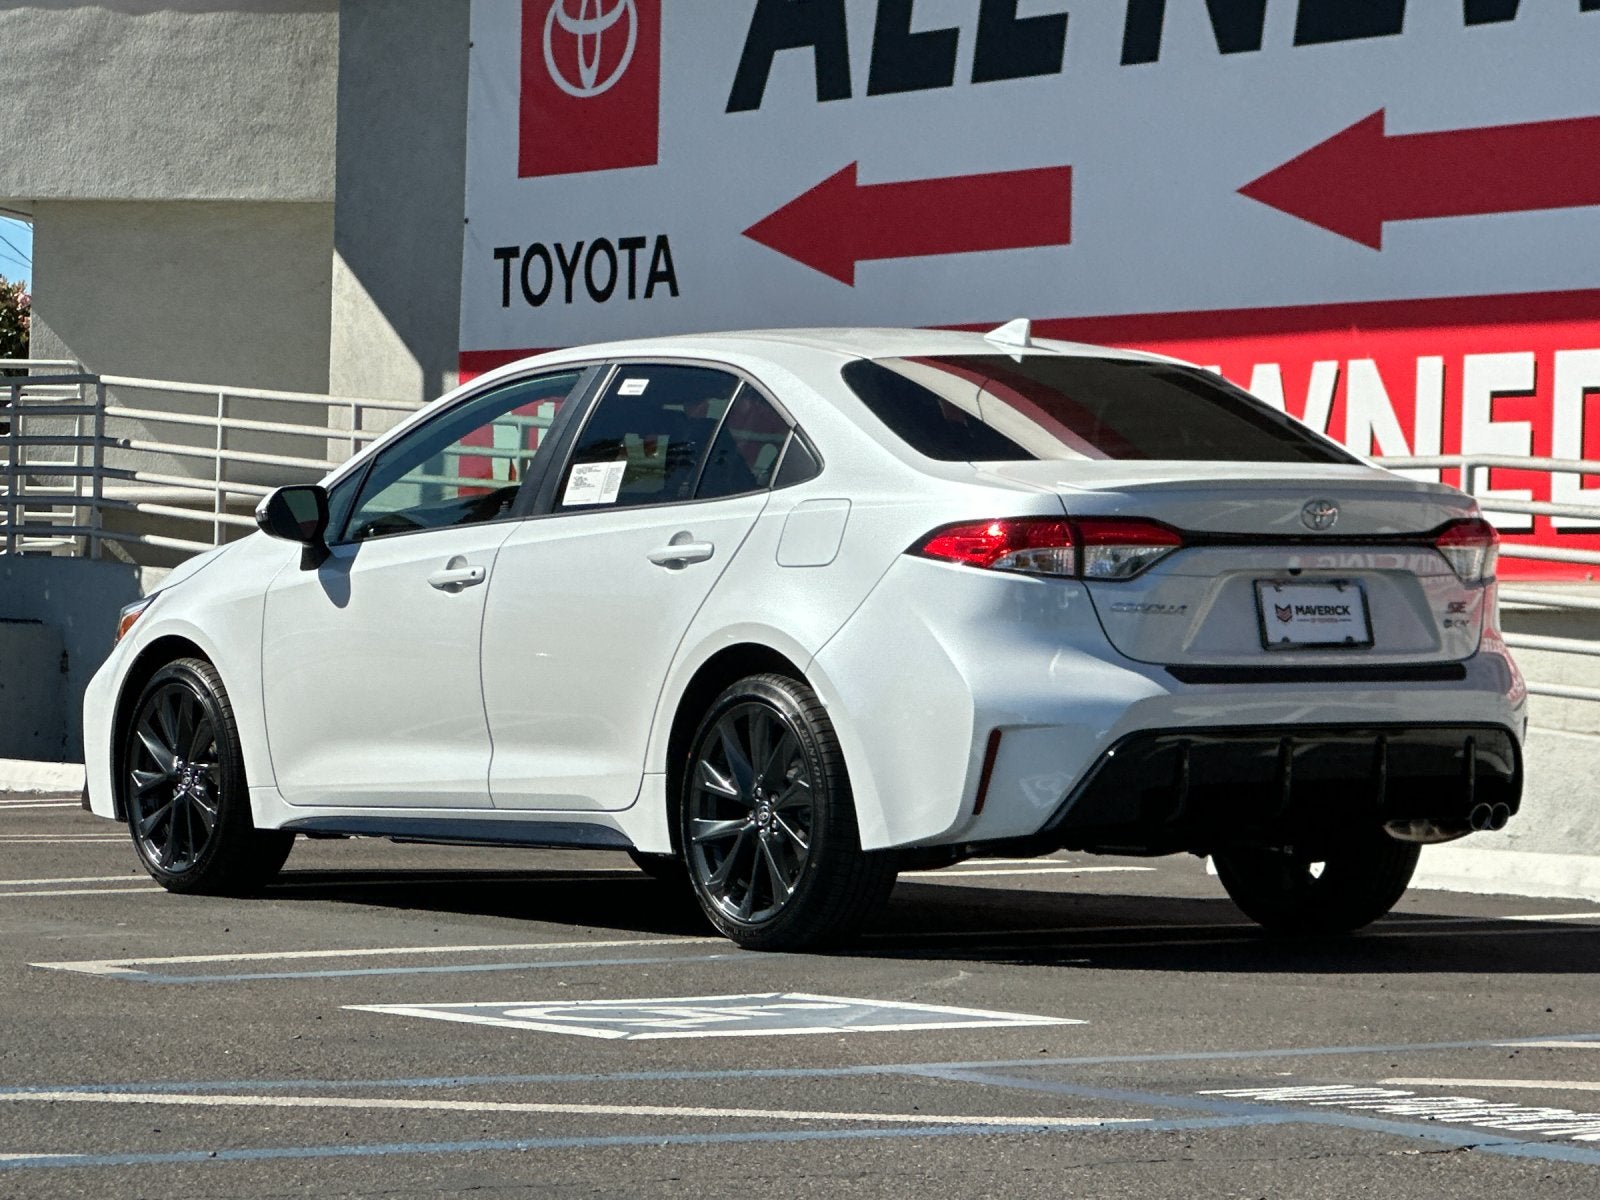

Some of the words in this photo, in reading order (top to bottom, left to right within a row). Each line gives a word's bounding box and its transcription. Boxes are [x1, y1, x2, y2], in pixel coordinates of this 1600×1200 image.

[494, 234, 680, 308] TOYOTA
[1203, 350, 1600, 534] NED
[1295, 604, 1351, 616] MAVERICK
